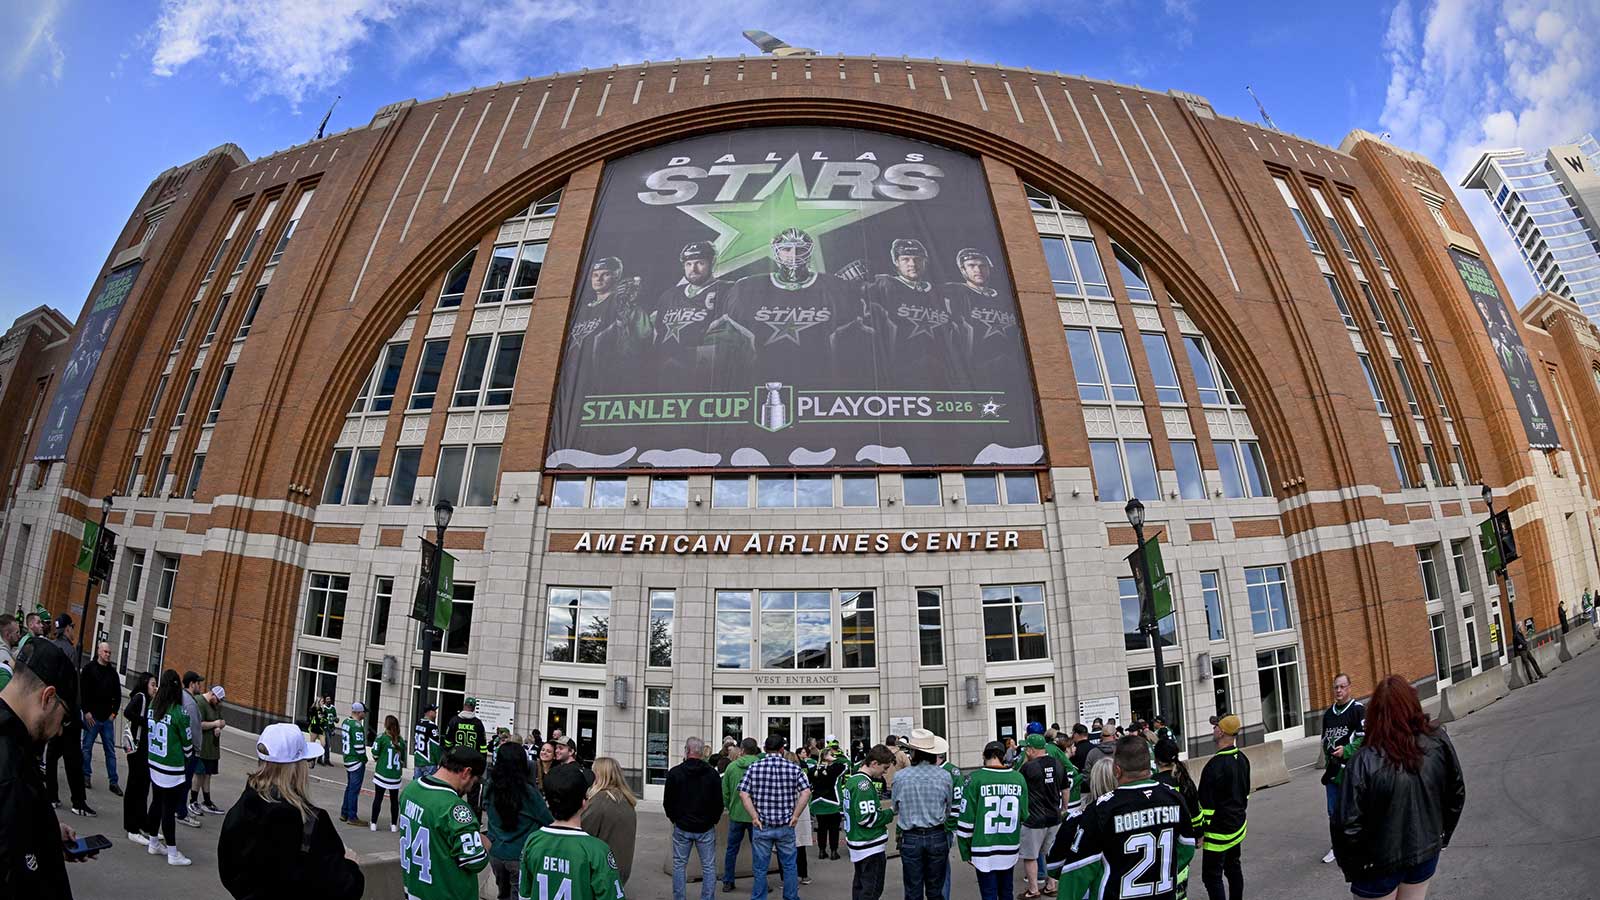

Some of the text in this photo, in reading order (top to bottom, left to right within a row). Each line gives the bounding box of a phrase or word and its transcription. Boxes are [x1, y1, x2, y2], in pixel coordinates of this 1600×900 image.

[667, 151, 925, 166] DALLAS
[1563, 155, 1585, 173] W
[637, 152, 945, 205] STARS
[662, 309, 707, 323] STARS
[754, 307, 831, 322] STARS
[581, 397, 750, 420] STANLEY CUP
[797, 396, 973, 417] PLAYOFFS 2026
[574, 530, 1020, 552] AMERICAN AIRLINES CENTER
[754, 675, 839, 684] WEST ENTRANCE
[148, 719, 168, 758] 29
[386, 748, 401, 770] 14
[980, 784, 1022, 797] OETTINGER
[859, 800, 876, 815] 96
[984, 795, 1020, 835] 29
[1114, 805, 1181, 834] ROBERTSON
[400, 813, 432, 885] 24
[460, 830, 483, 855] 24
[543, 855, 570, 875] BENN
[1120, 827, 1174, 900] 21
